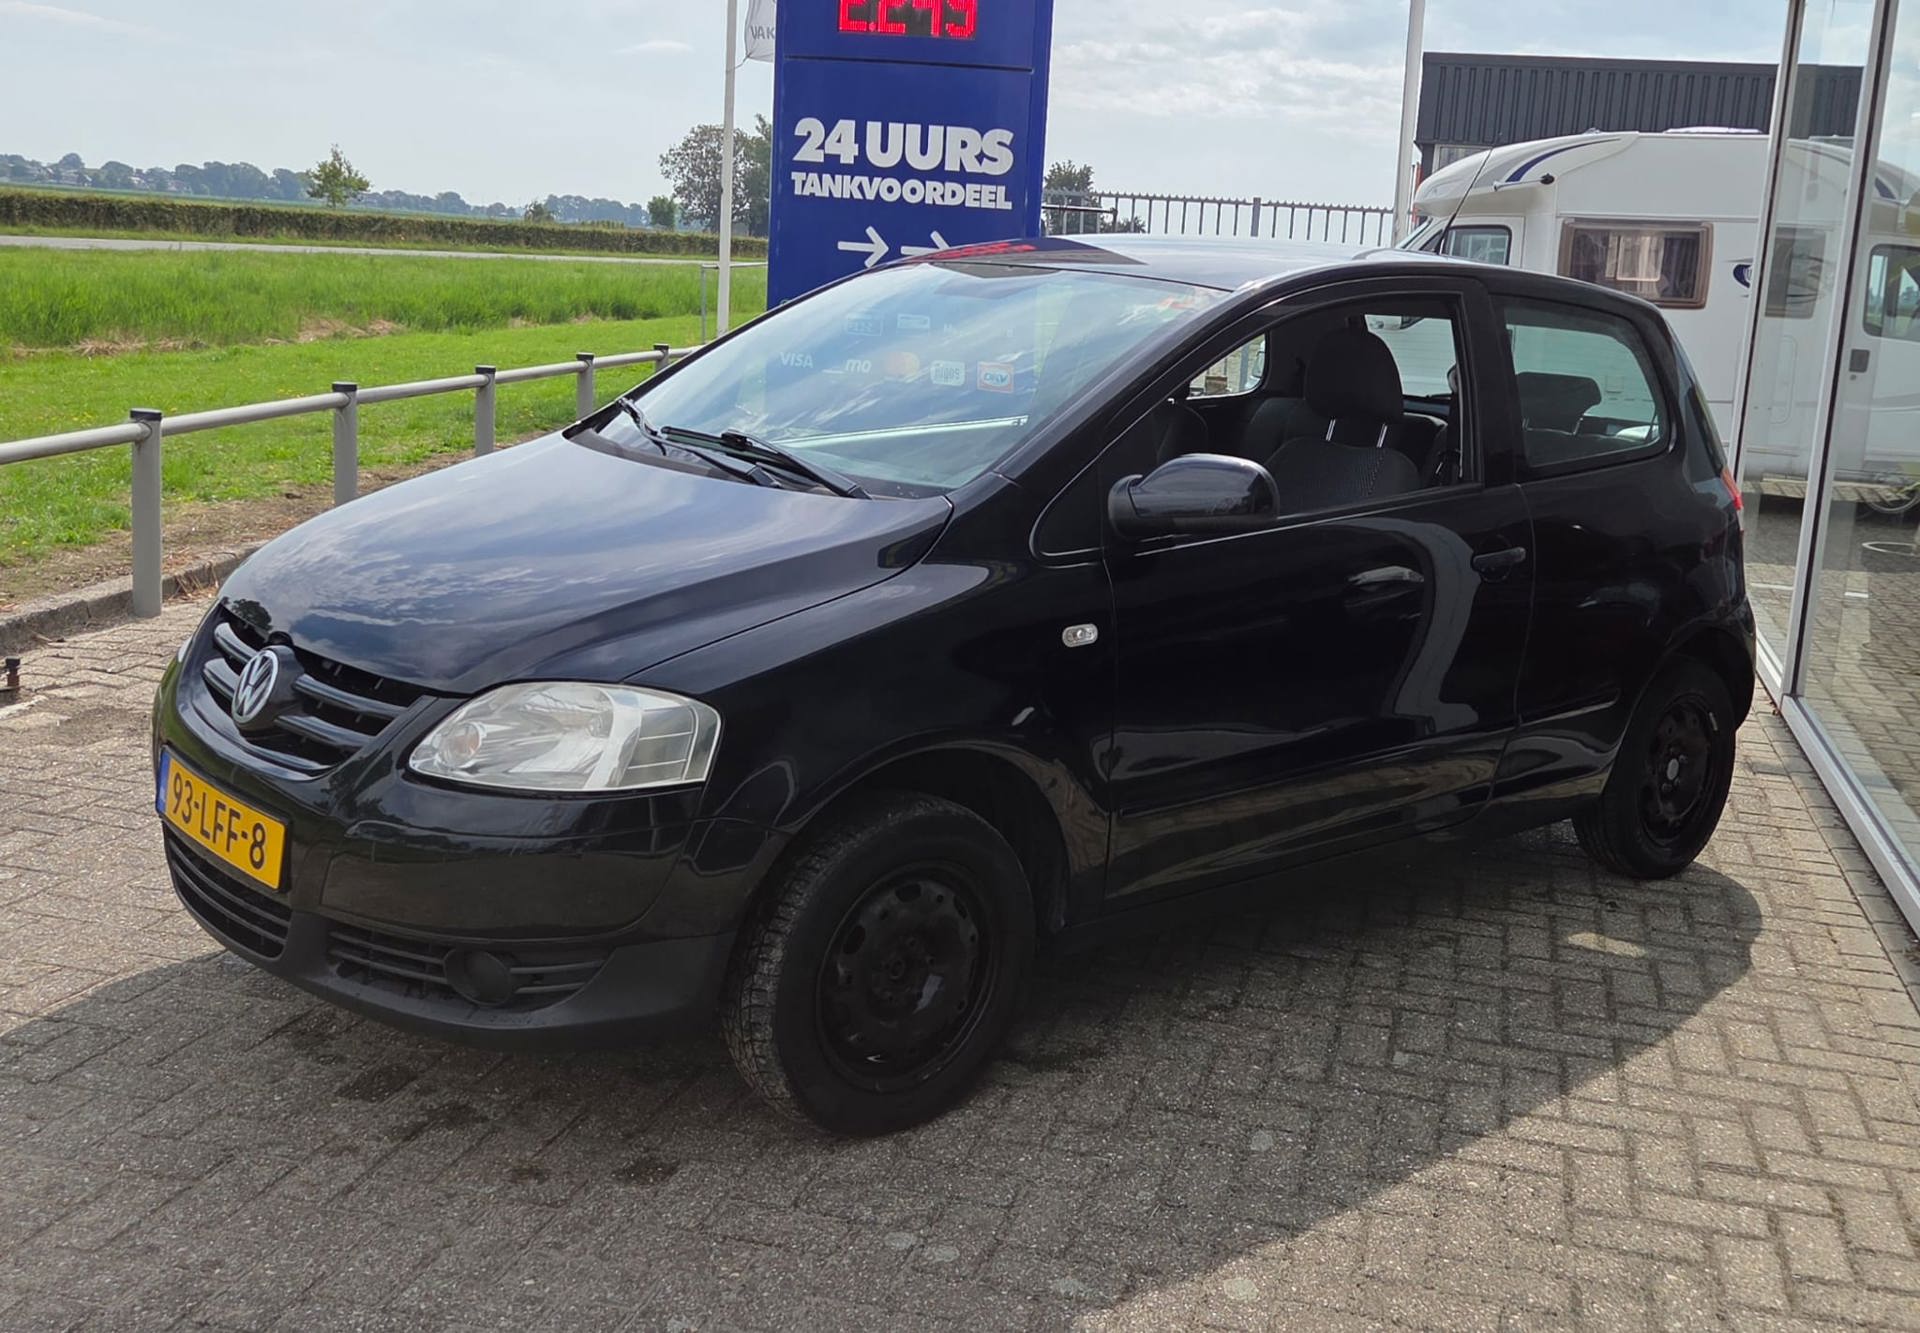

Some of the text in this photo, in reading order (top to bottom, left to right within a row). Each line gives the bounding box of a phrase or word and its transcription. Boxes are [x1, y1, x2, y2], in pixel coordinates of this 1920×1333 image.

[793, 117, 1014, 175] 24 UURS
[791, 171, 1013, 210] TANKVOORDEEL
[780, 351, 813, 368] VISA
[172, 771, 267, 870] 93-LFF-8
